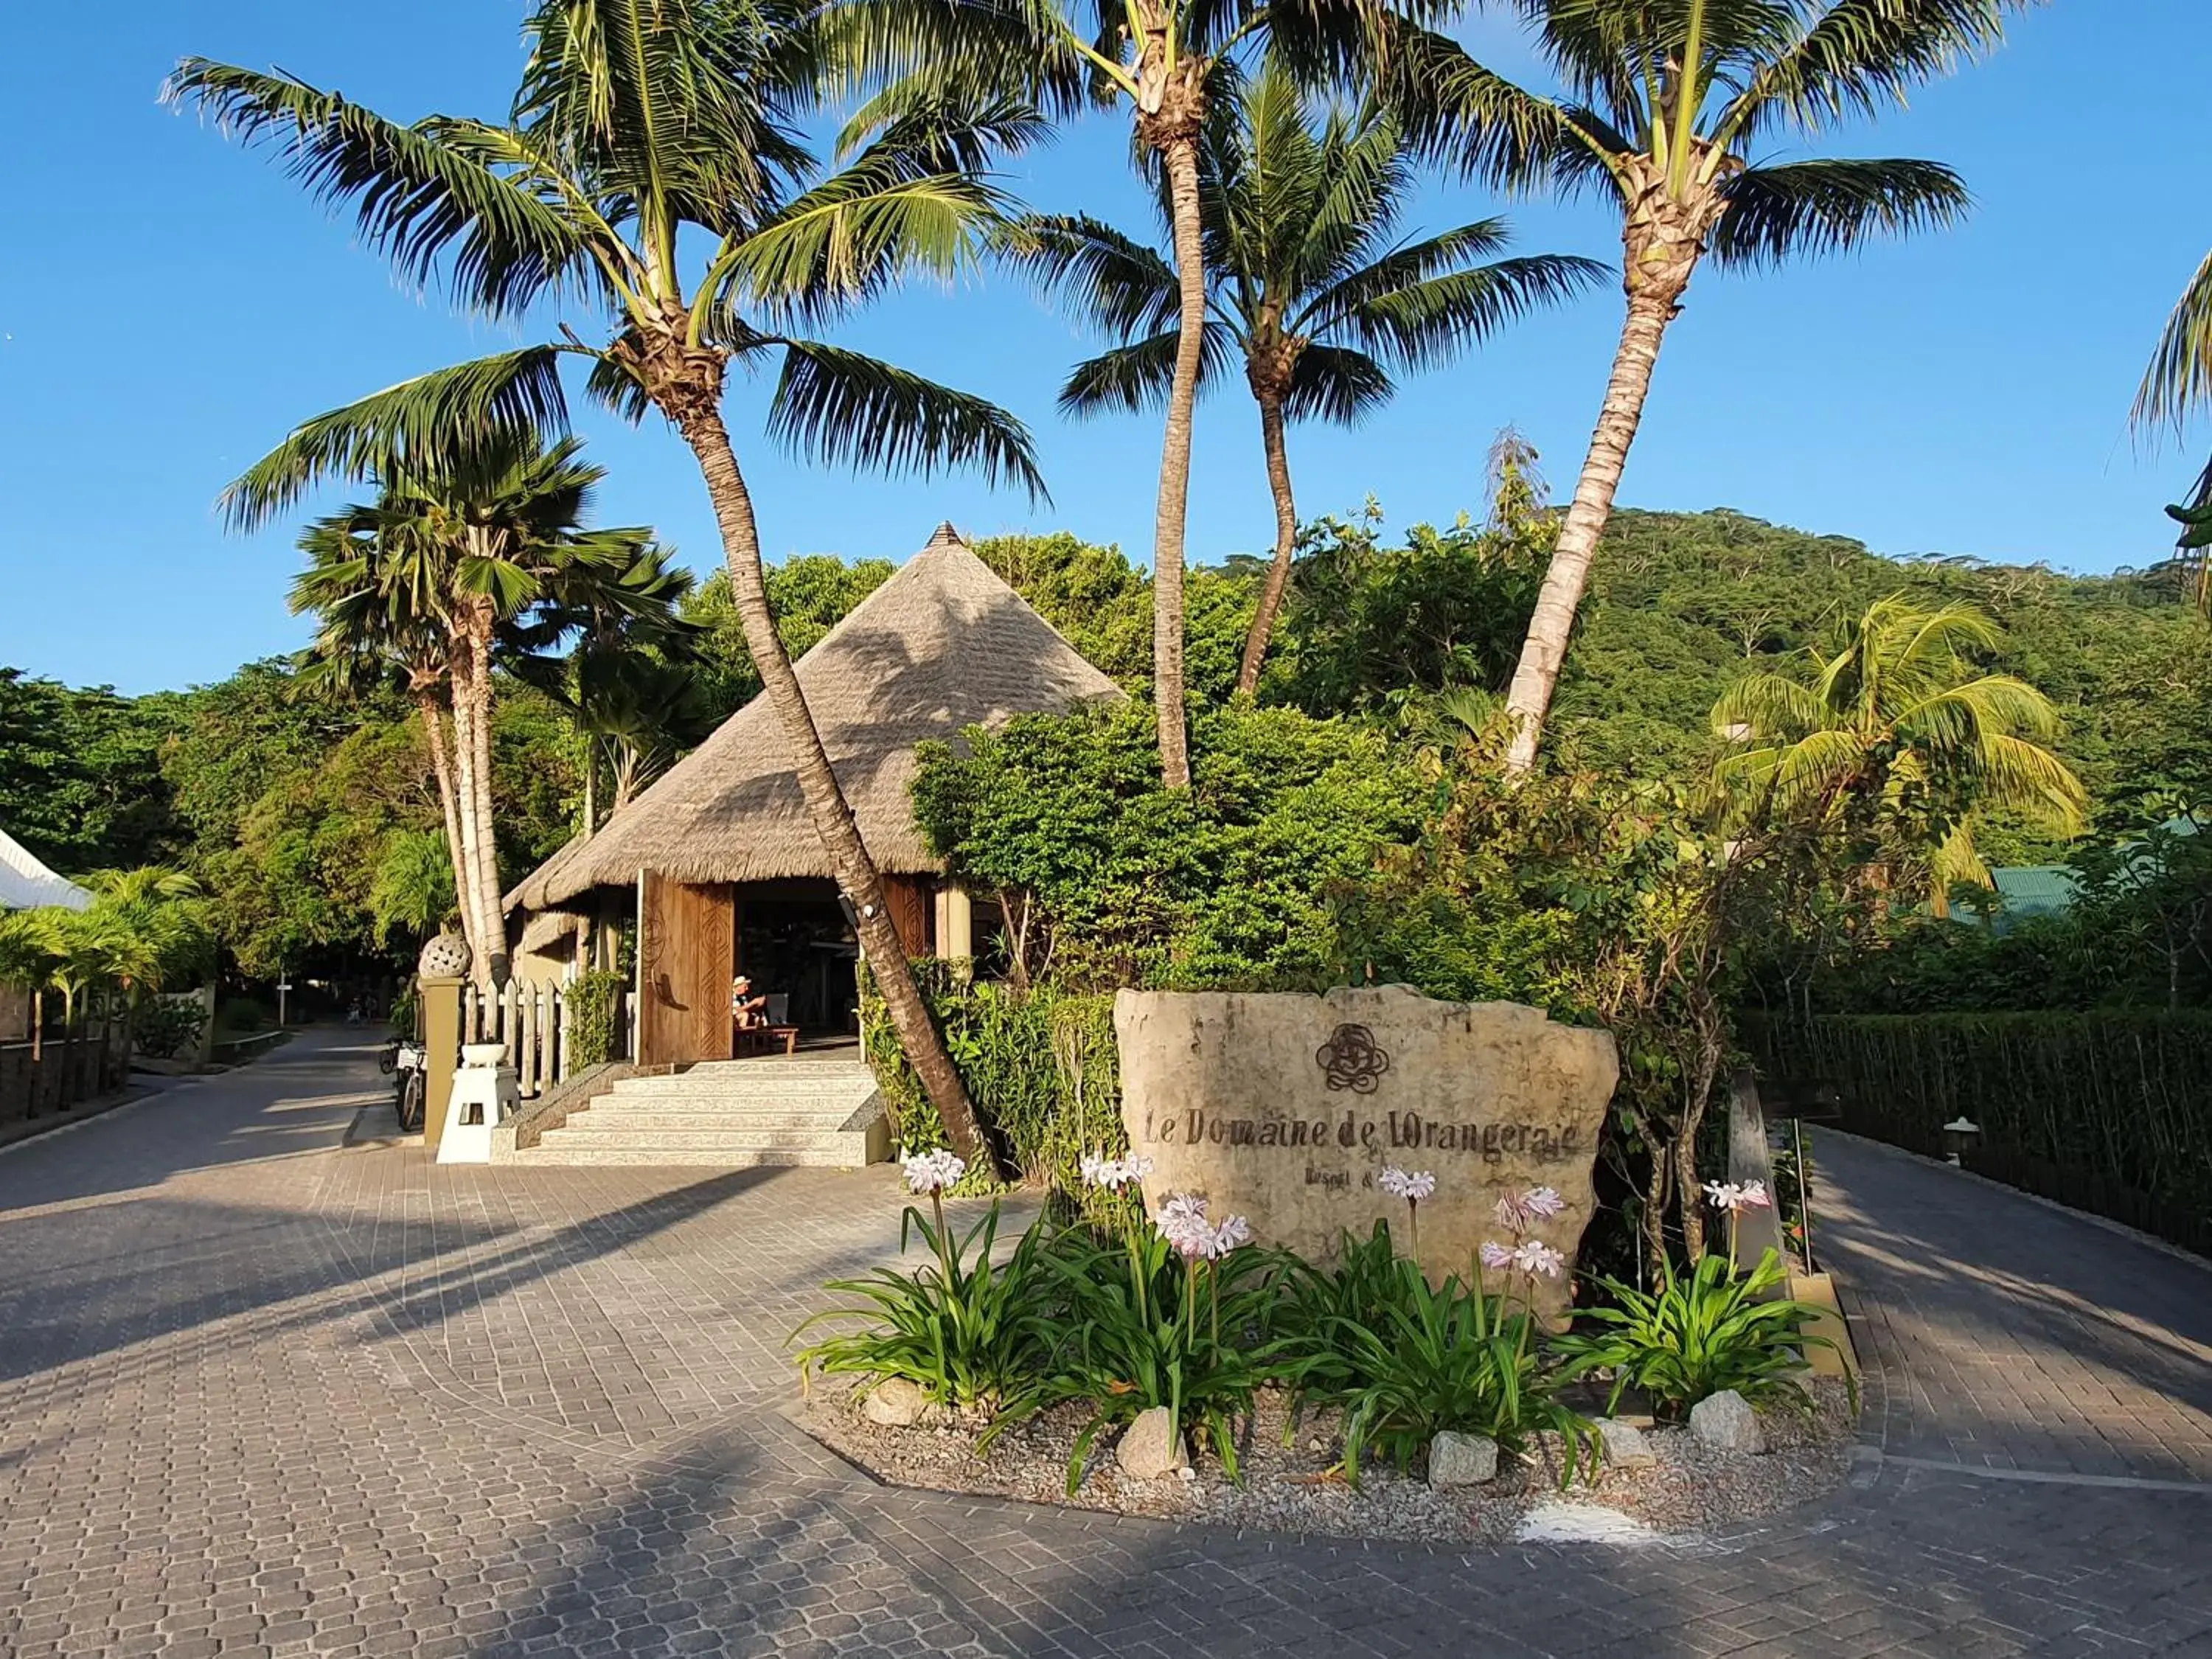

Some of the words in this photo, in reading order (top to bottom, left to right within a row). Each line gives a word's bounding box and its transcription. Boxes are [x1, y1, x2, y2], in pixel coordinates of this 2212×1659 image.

[1144, 1108, 1175, 1144] Le
[1186, 1108, 1327, 1147] Domaine
[1338, 1110, 1375, 1148] de
